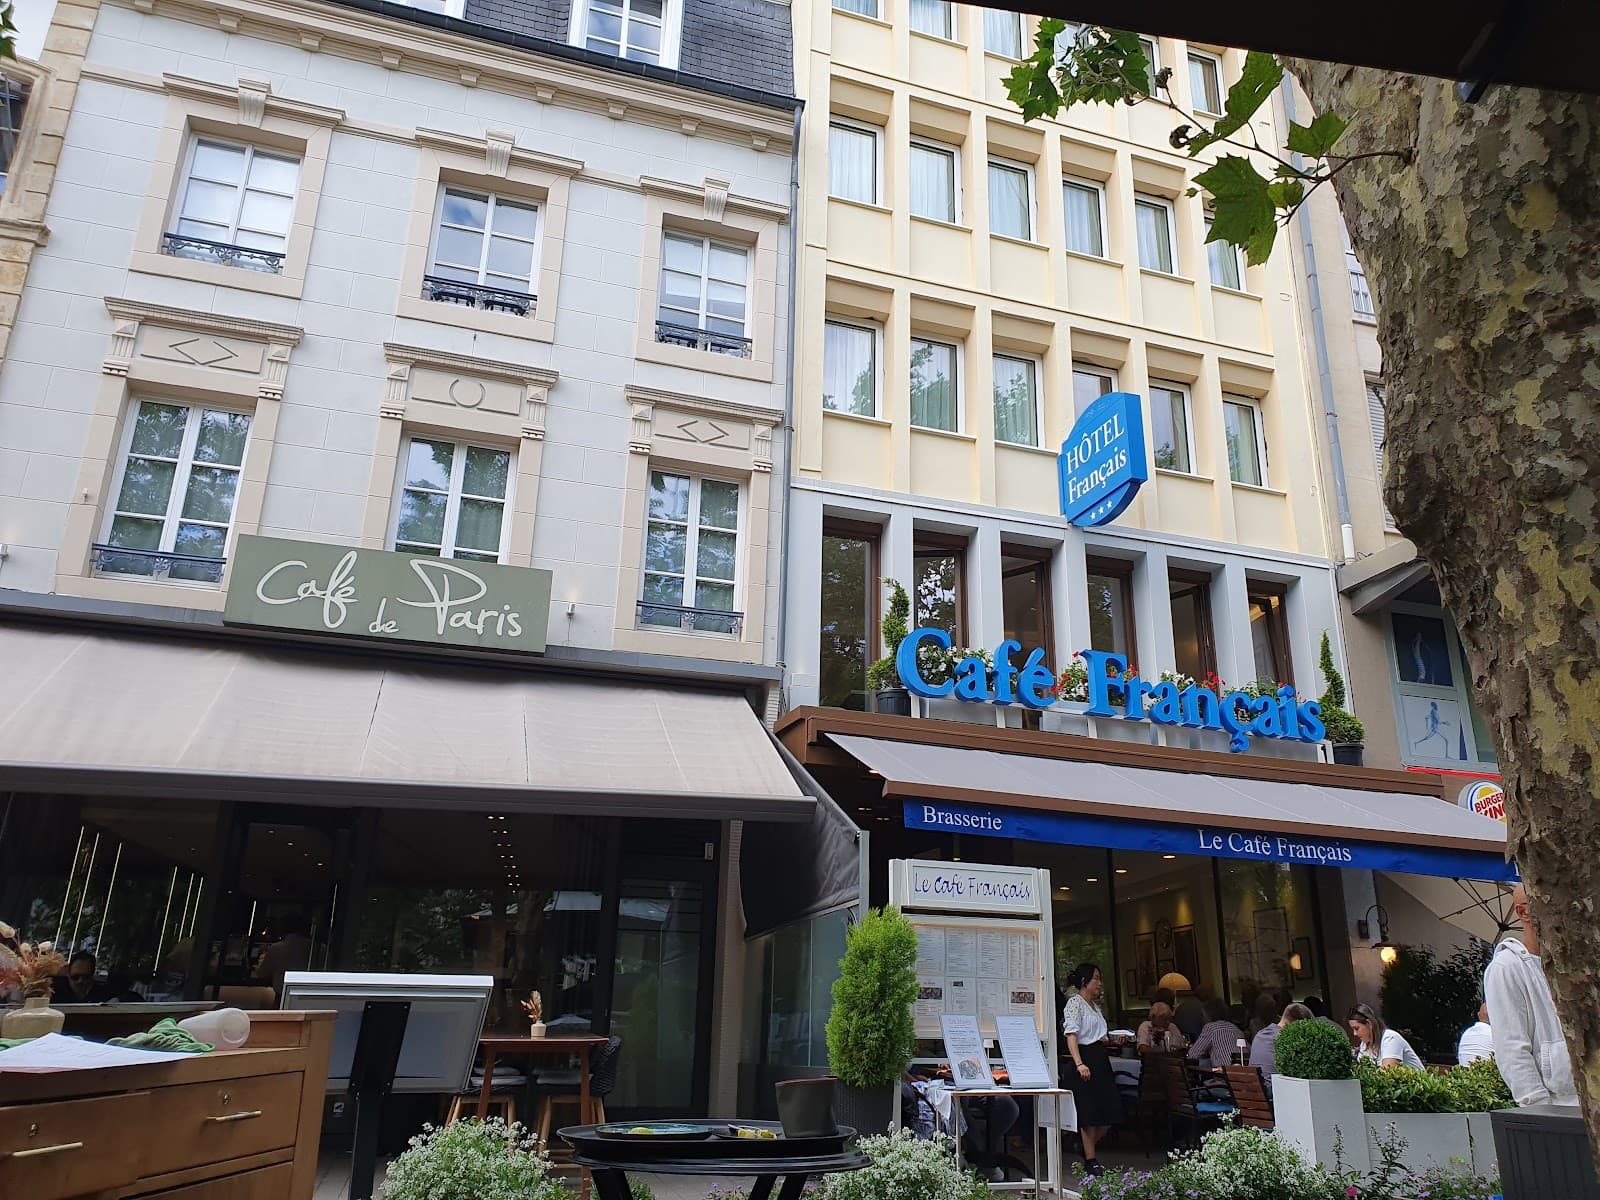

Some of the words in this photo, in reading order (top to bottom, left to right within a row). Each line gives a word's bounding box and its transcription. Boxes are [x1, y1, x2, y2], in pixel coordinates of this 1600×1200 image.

[1066, 413, 1125, 475] HÔTEL
[1068, 446, 1128, 504] Français
[257, 551, 358, 628] Café
[369, 598, 399, 633] de
[397, 559, 522, 637] Paris
[897, 627, 1056, 709] Café
[1079, 648, 1327, 753] Français
[922, 805, 1003, 830] Brasserie
[1480, 802, 1505, 820] IN
[1197, 829, 1223, 850] Le
[1228, 832, 1272, 855] Café
[1276, 837, 1352, 864] Français
[914, 871, 931, 893] Le
[968, 877, 1033, 901] Français
